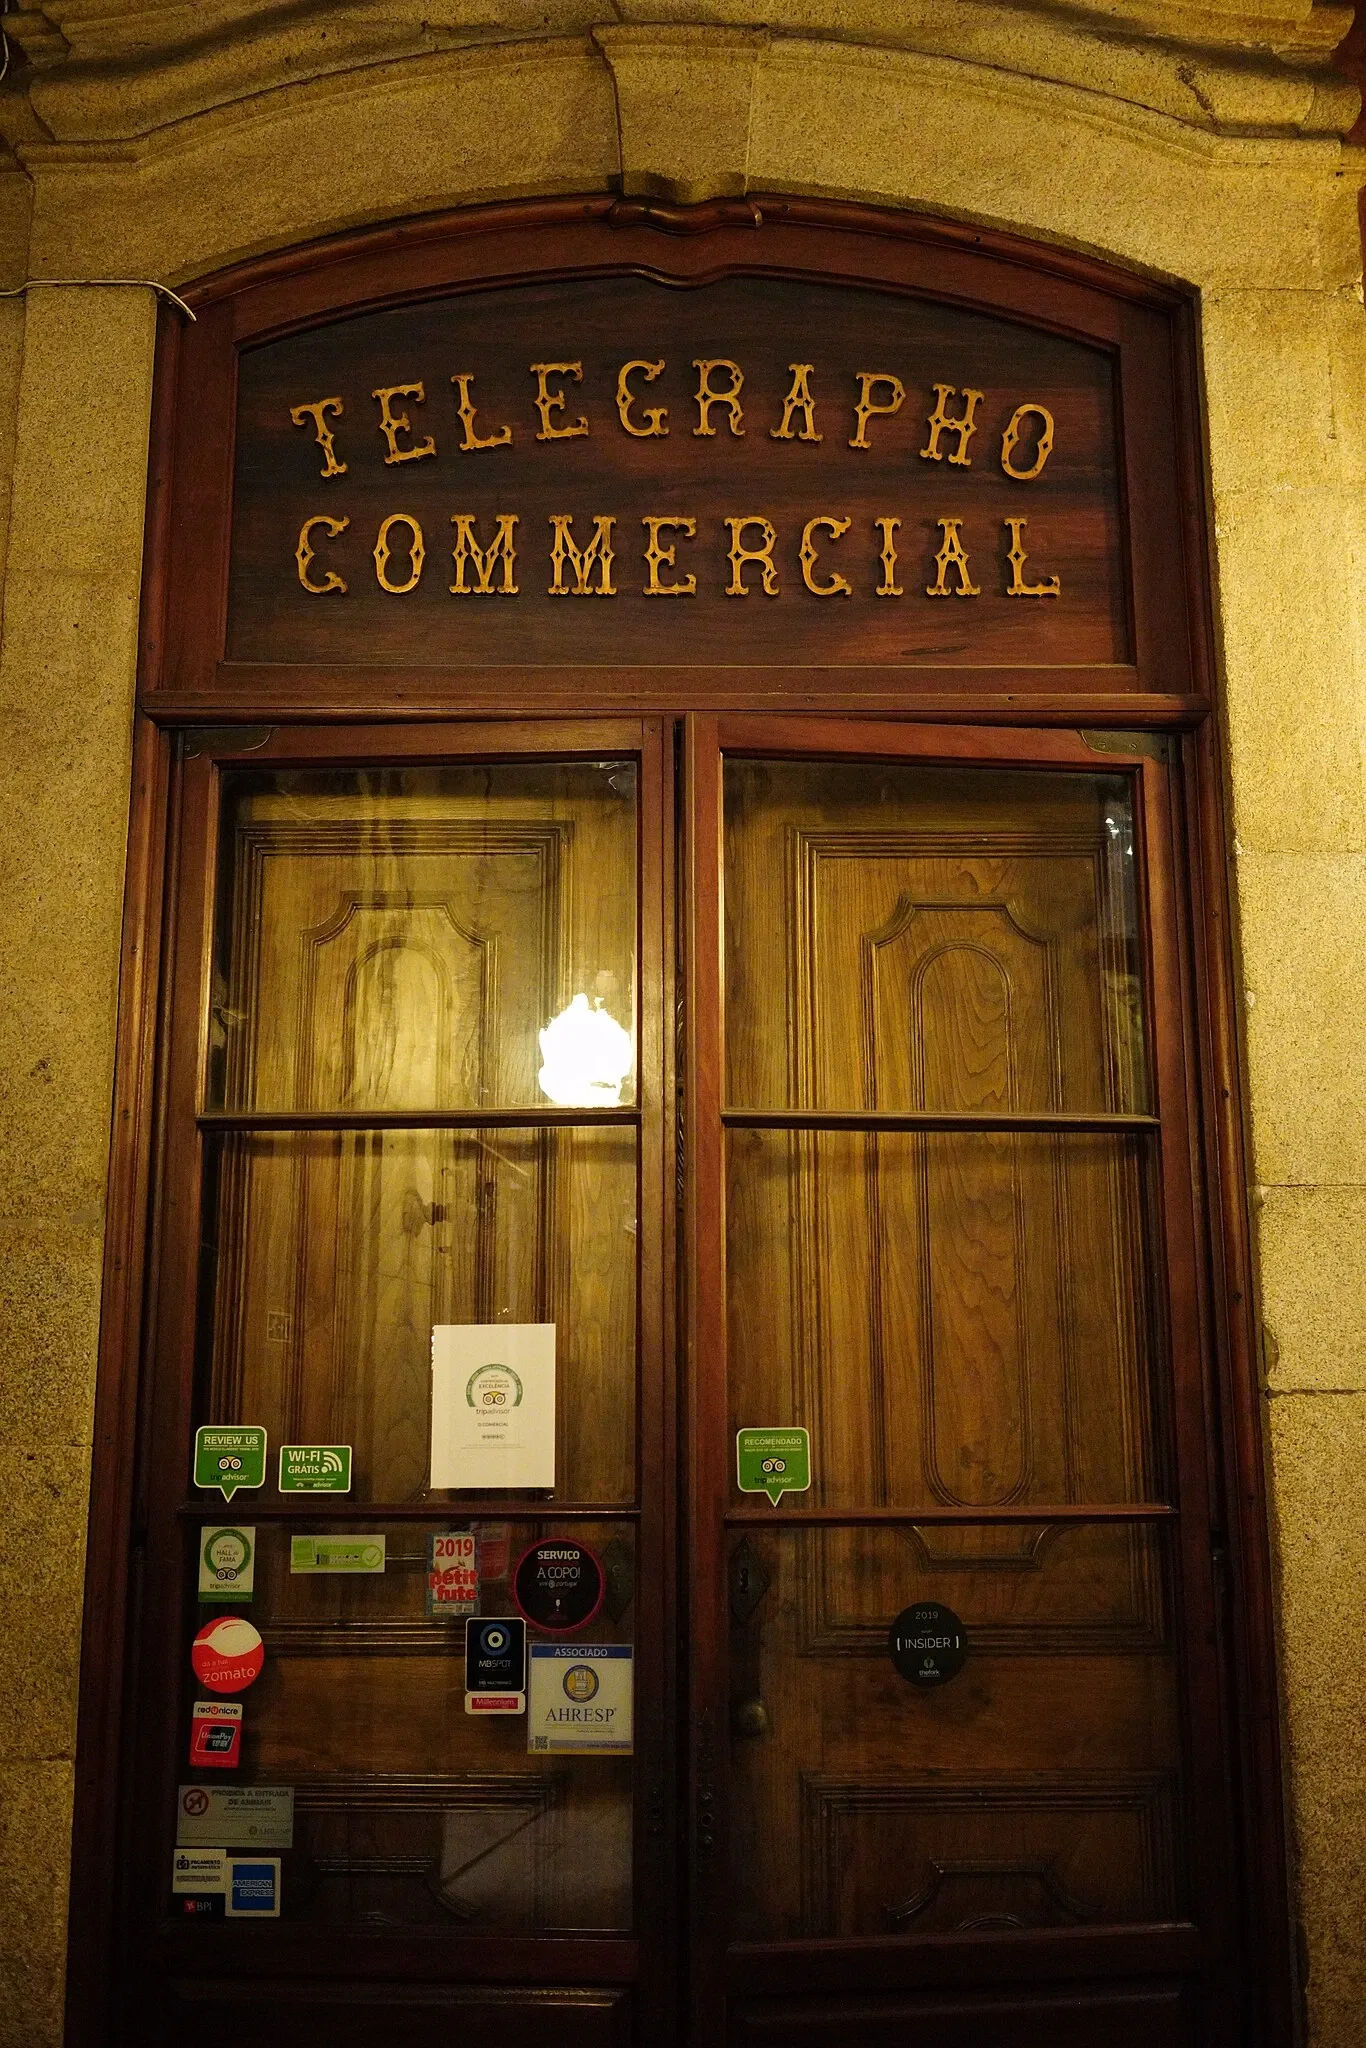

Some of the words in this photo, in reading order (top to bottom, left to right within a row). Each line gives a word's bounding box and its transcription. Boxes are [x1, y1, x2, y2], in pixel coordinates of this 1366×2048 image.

[289, 358, 1056, 482] TELEGRAPHO
[293, 512, 1061, 599] COMMERCIAL
[204, 1436, 242, 1445] REVIEW
[245, 1436, 259, 1445] US
[744, 1438, 802, 1446] RECOMENDADO
[288, 1450, 320, 1462] WI-FI
[287, 1463, 320, 1474] GRÁTIS
[435, 1538, 473, 1557] 2019
[537, 1550, 580, 1560] SERVIÇO
[536, 1566, 547, 1579] A
[547, 1566, 580, 1579] COPO!
[915, 1610, 939, 1620] 2019
[904, 1637, 951, 1649] INSIDER
[554, 1648, 608, 1657] ASSOCIADO
[203, 1667, 256, 1683] zomato
[545, 1708, 614, 1722] AHRESP
[232, 1879, 273, 1888] AMERICAN
[240, 1888, 275, 1897] EXPRESS
